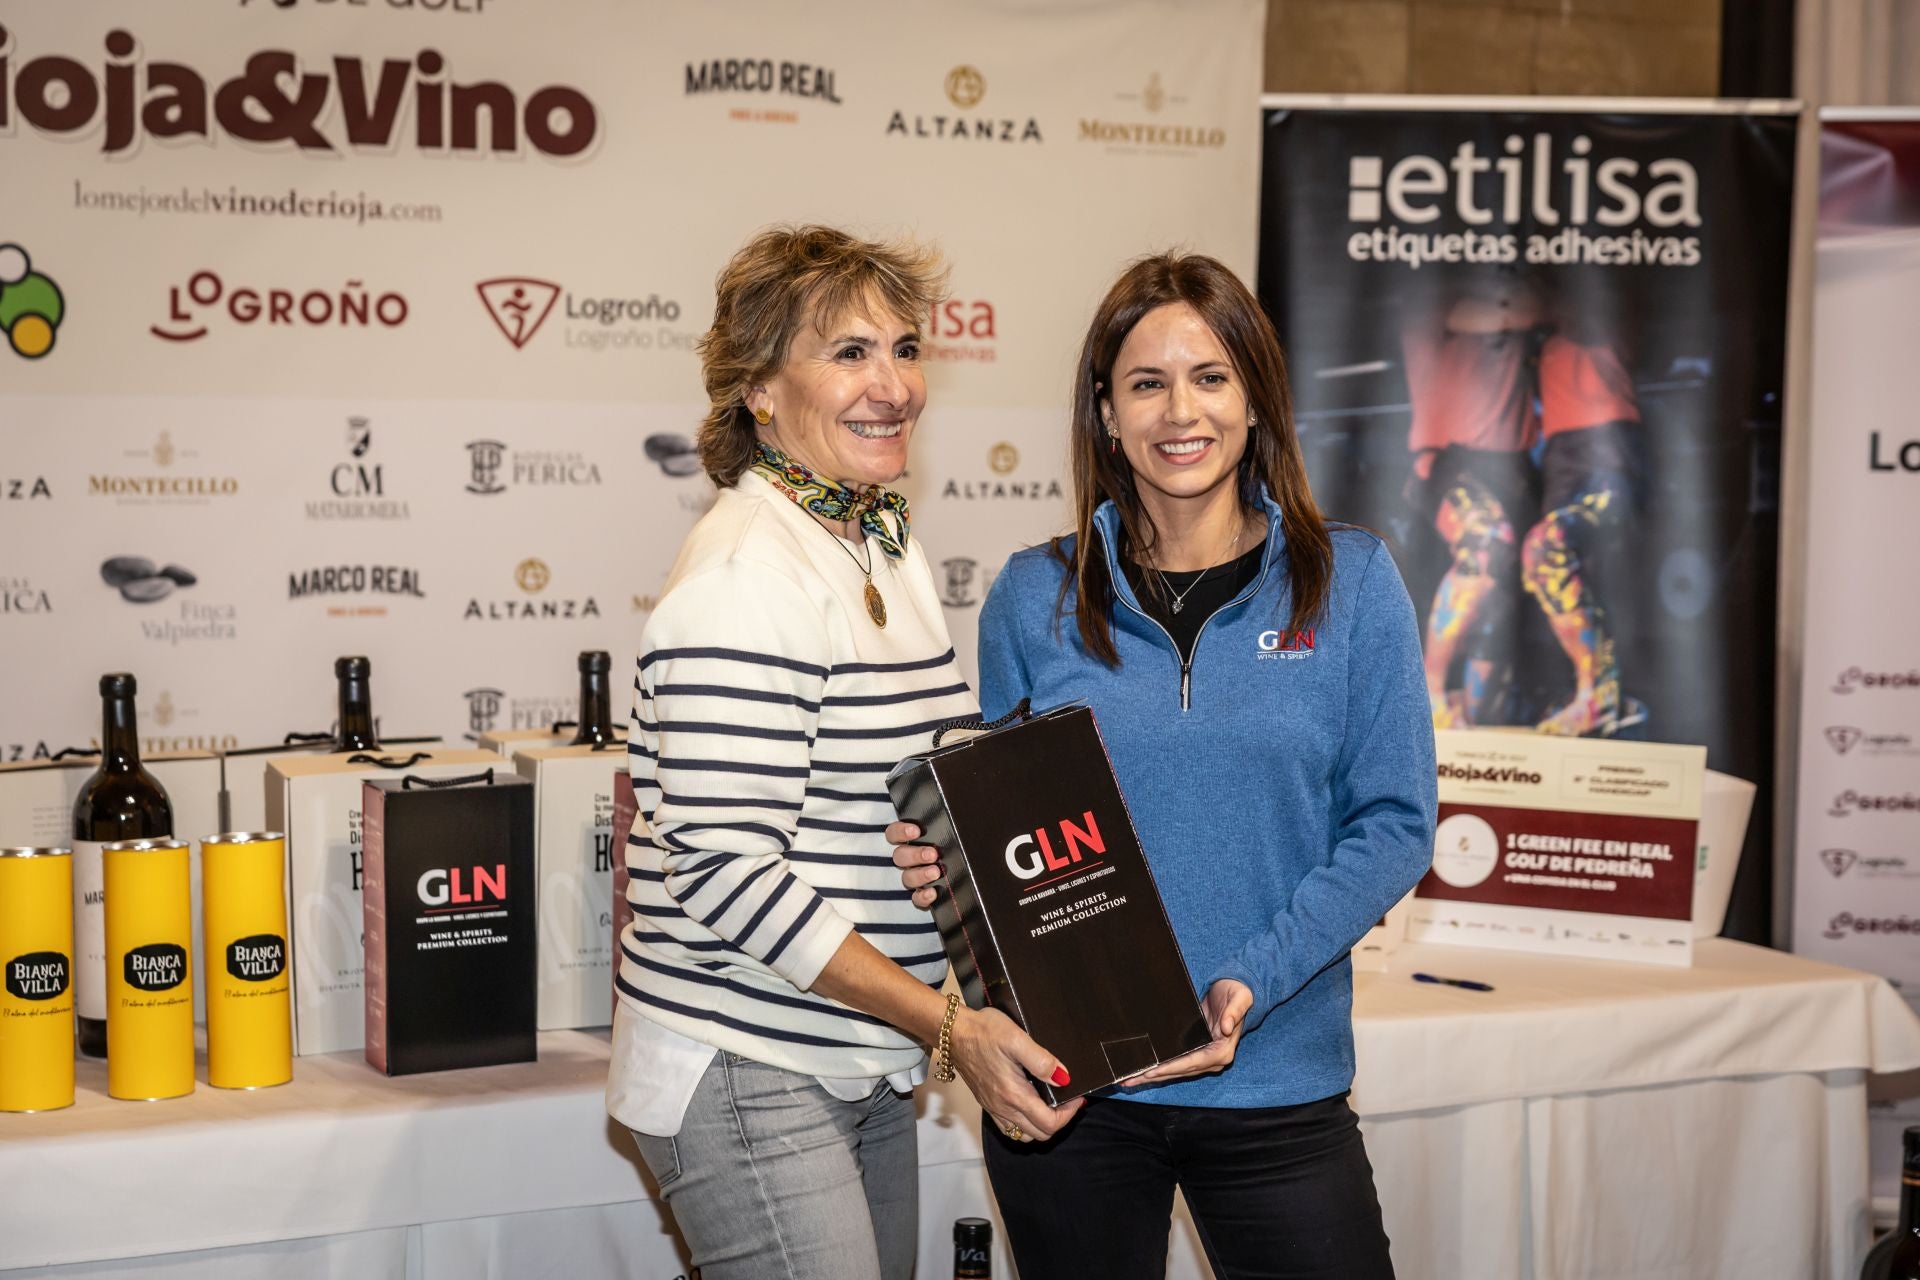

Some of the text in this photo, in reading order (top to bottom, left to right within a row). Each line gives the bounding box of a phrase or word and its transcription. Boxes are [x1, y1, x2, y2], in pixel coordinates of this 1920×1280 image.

[0, 25, 598, 157] oja&Vino
[686, 59, 842, 104] MARCO REAL
[886, 109, 1043, 143] ALTANZA
[1078, 118, 1226, 149] MONTECILLO
[1385, 132, 1702, 228] etilisa
[1348, 226, 1702, 269] etiquetas adhesivas
[170, 270, 408, 326] LOGROÑO
[566, 292, 681, 326] Logroño
[565, 327, 653, 351] Logroño
[88, 474, 240, 496] MONTECILLO
[331, 463, 382, 497] CM
[513, 463, 602, 485] PERICA
[0, 477, 52, 499] ZA
[942, 480, 1063, 499] ALTANZA
[289, 565, 425, 600] MARCO REAL
[463, 597, 602, 620] ALTANZA
[1258, 627, 1315, 651] GLN
[1257, 652, 1278, 660] WINE
[0, 740, 50, 763] ZA
[1437, 764, 1542, 784] Rioja&Vino
[1005, 810, 1106, 880] GLN
[1506, 833, 1673, 861] 1 GREEN FEE EN REAL
[1505, 852, 1549, 870] GOLF
[1549, 855, 1573, 872] DE
[1574, 858, 1654, 879] PEDREÑA
[416, 864, 506, 906] GLN
[1030, 895, 1127, 938] PREMIUM COLLECTION
[1040, 891, 1107, 922] WINE & SPIRITS
[417, 935, 508, 950] PREMIUM COLLECTION
[430, 931, 452, 940] WINE
[461, 928, 492, 938] SPIRITS
[132, 954, 181, 972] BIANCA
[235, 944, 281, 962] BIANCA
[15, 963, 65, 980] BIANCA
[137, 969, 178, 985] VILLA
[240, 959, 279, 976] VILLA
[20, 978, 61, 994] VILLA
